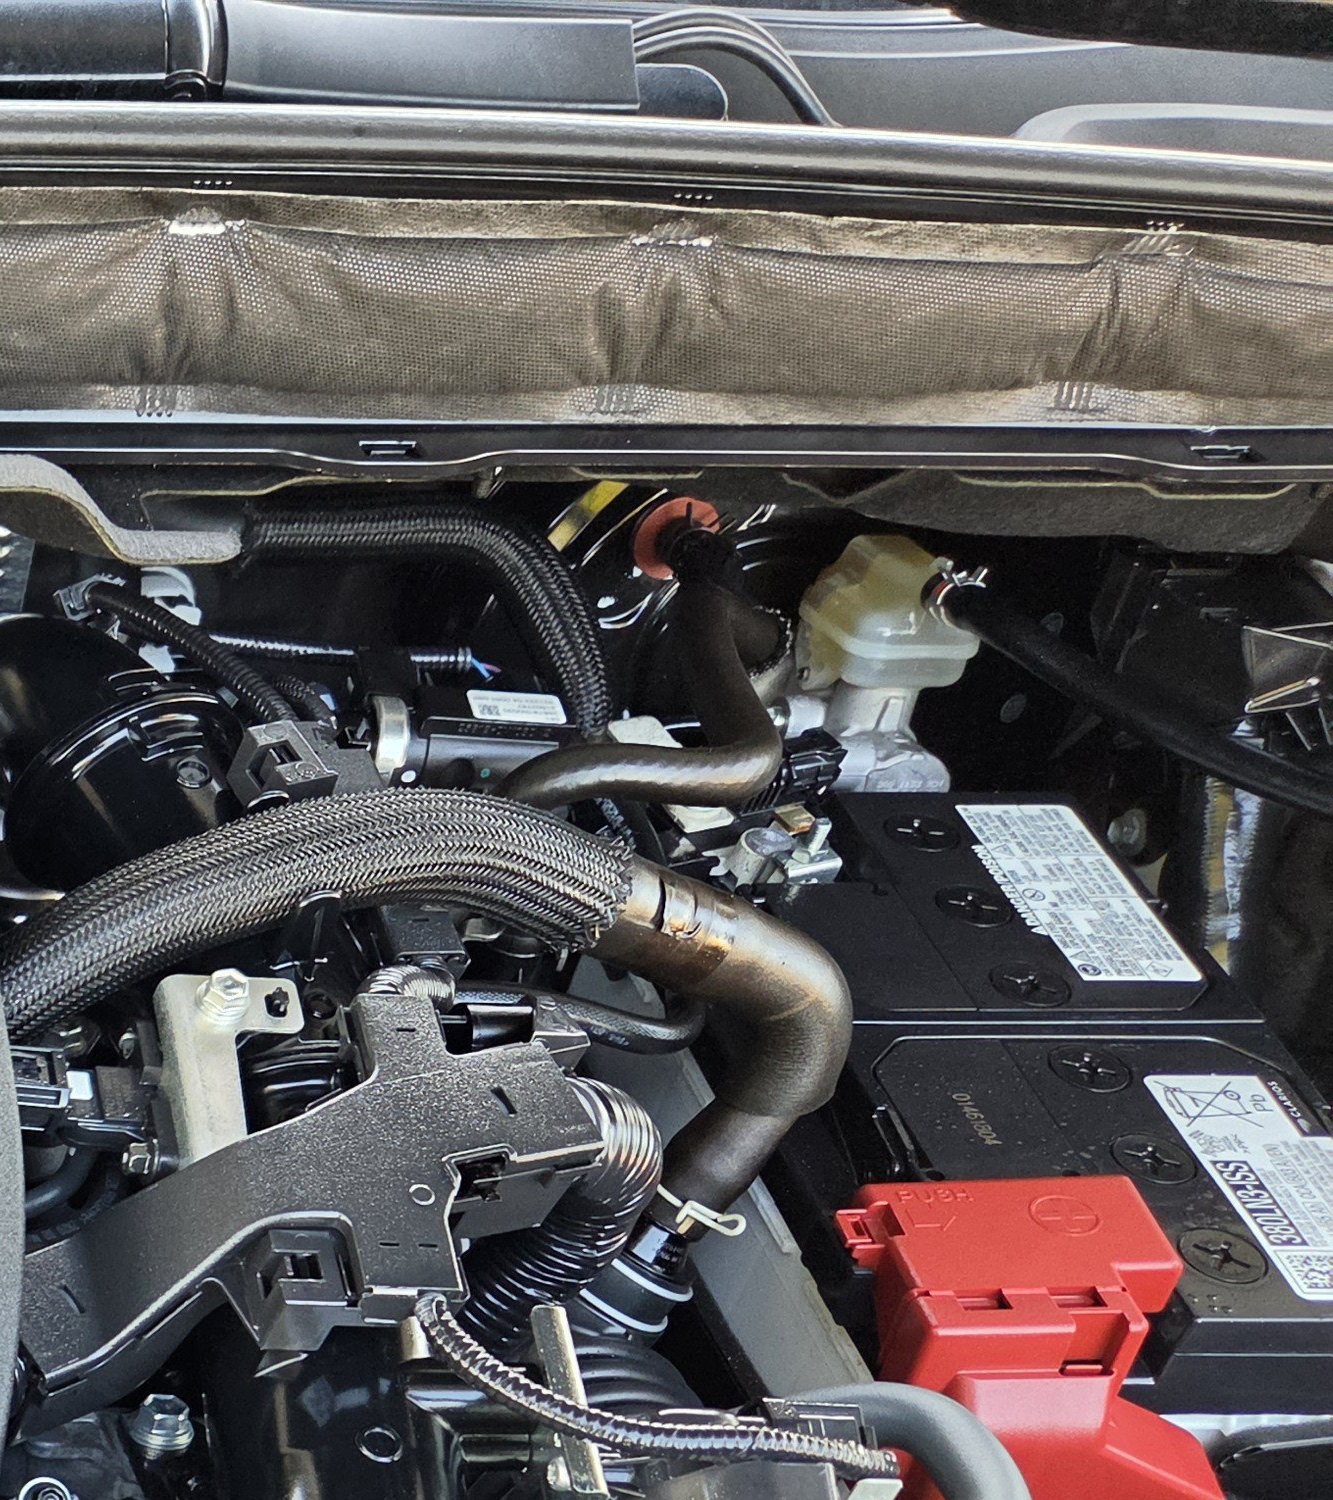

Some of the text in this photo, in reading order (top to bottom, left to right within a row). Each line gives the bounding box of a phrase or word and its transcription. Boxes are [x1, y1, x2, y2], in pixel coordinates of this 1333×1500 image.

[1251, 1093, 1274, 1113] Pb
[1268, 1080, 1301, 1120] CLARIOS
[895, 1188, 974, 1204] PUSH
